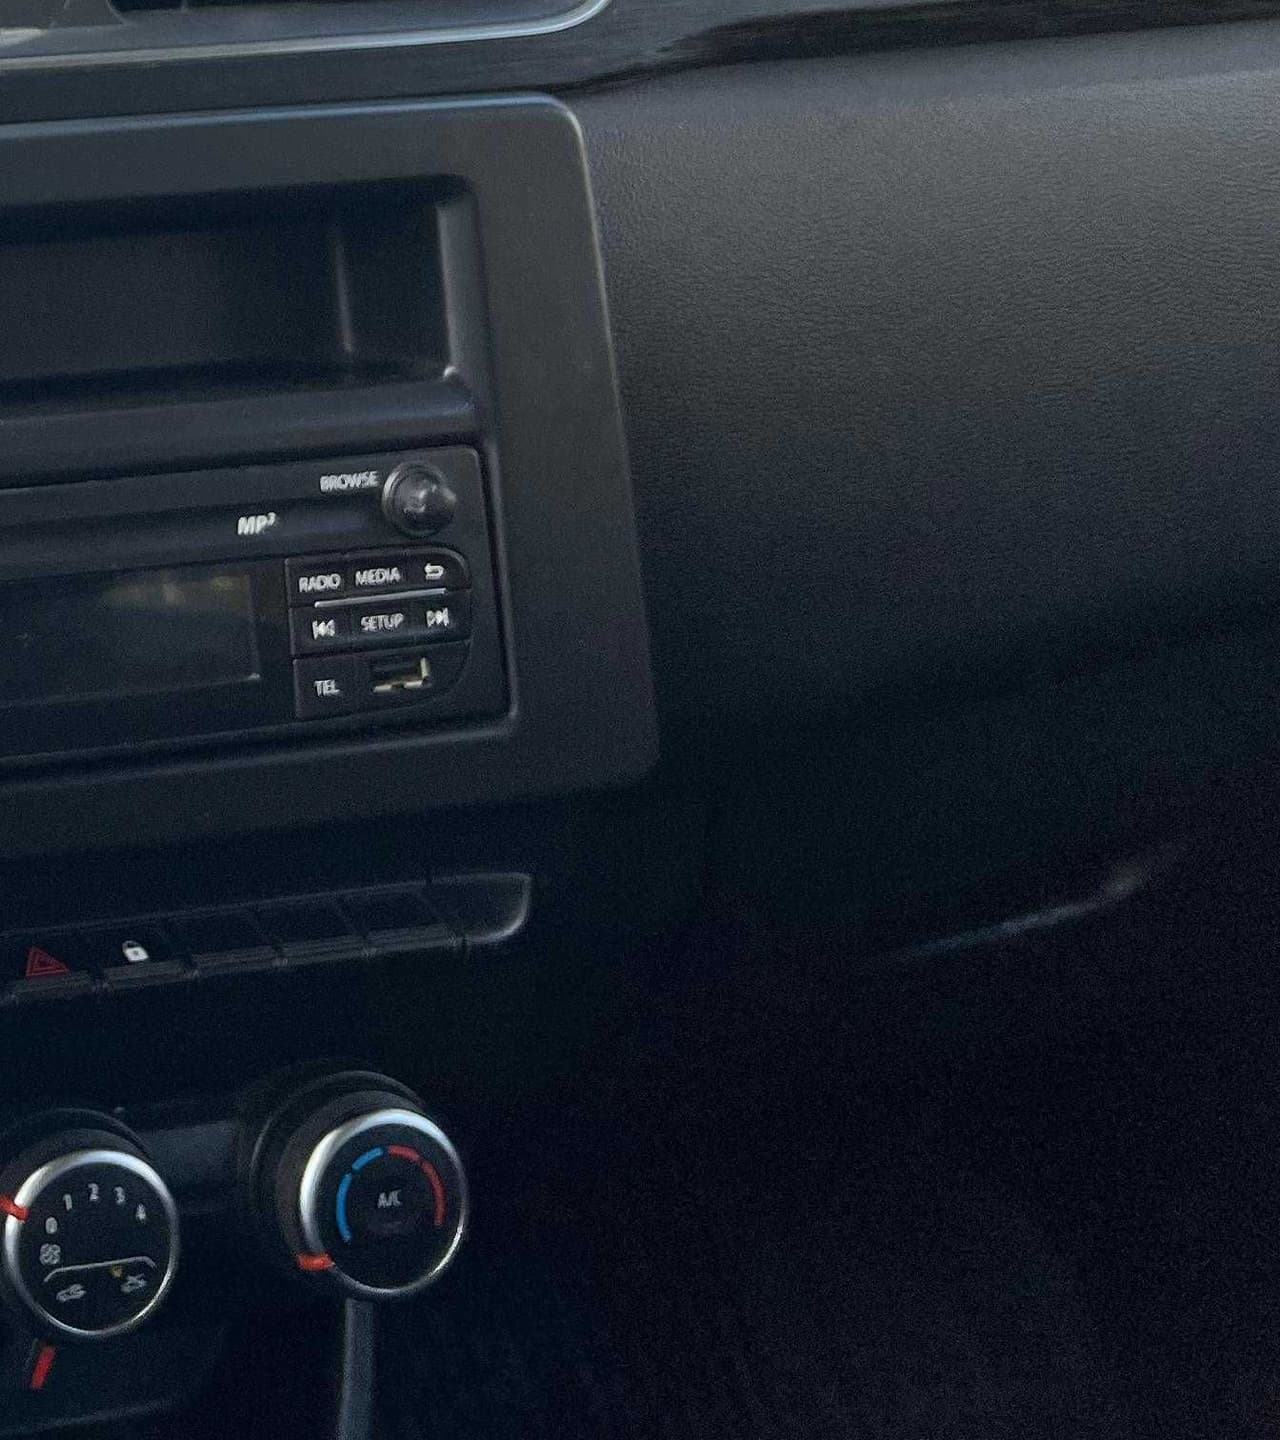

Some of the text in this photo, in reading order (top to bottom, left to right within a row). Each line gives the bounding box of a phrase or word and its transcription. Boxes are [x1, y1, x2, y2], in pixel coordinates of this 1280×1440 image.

[319, 470, 379, 492] BROWSE
[298, 573, 342, 592] RADIO
[355, 567, 402, 585] MEDIA
[360, 613, 404, 632] SETUP
[314, 679, 340, 696] TEL
